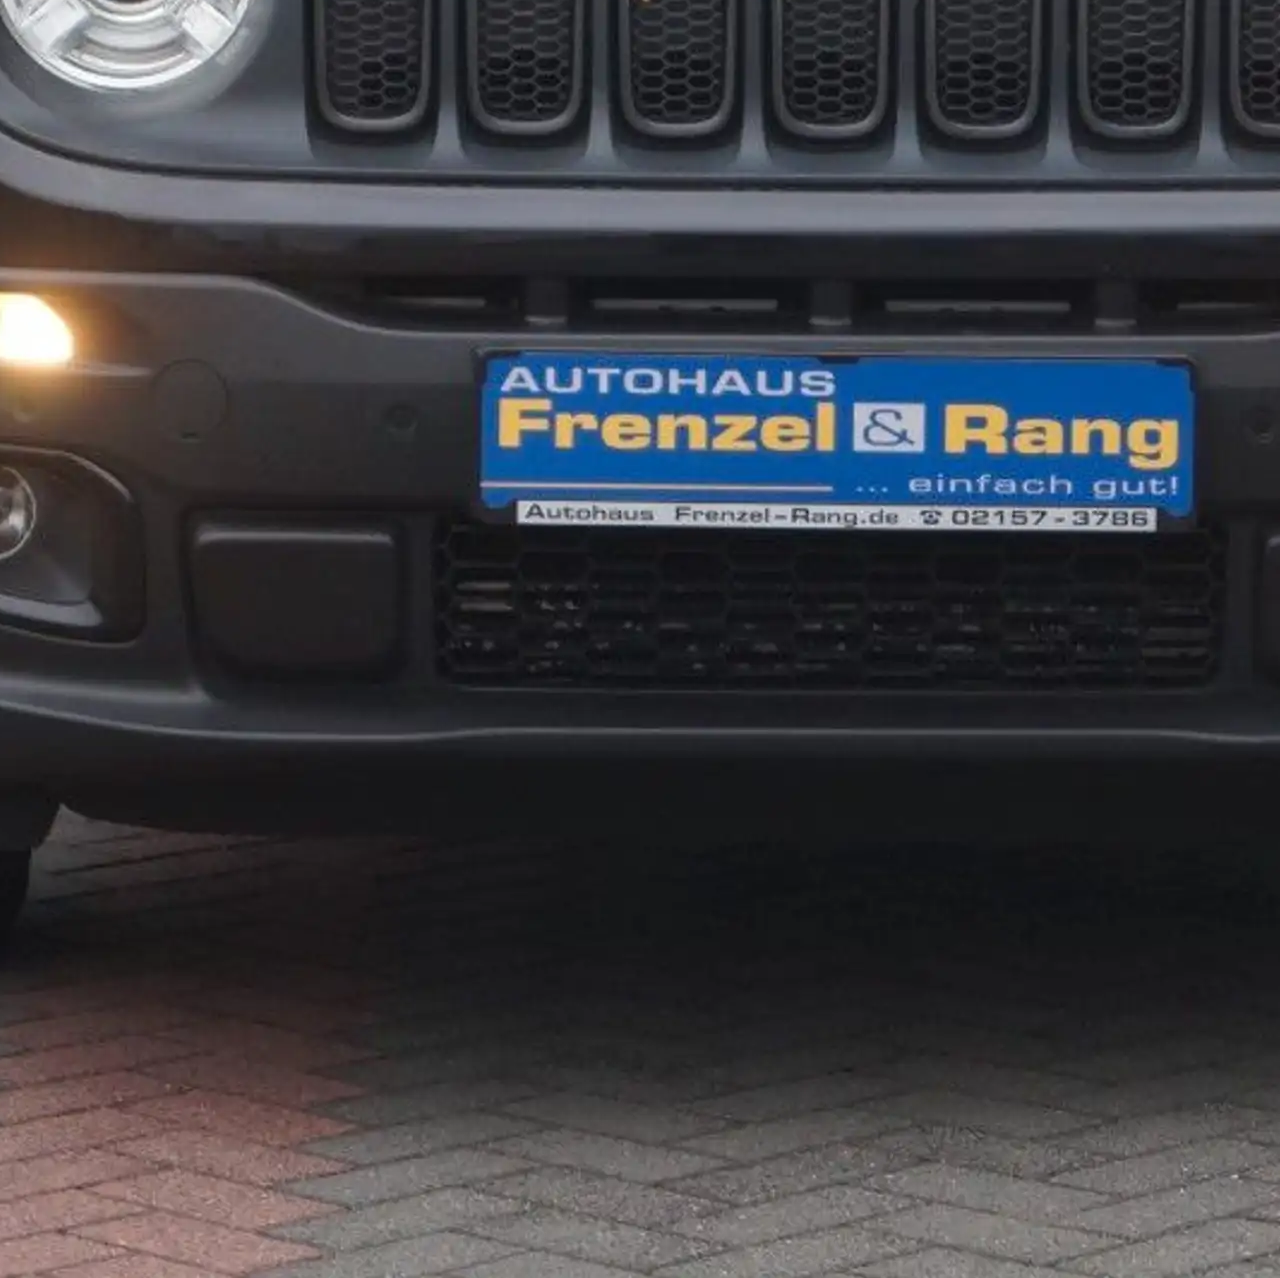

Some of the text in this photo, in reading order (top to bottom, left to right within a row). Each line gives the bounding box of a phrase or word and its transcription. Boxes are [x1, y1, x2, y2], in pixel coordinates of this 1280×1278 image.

[499, 366, 837, 397] AUTOHAUS
[497, 397, 1180, 470] Frenzel & Rang
[907, 473, 1074, 497] einfach
[1092, 476, 1180, 501] gut!
[524, 503, 656, 523] Autohaus
[674, 505, 900, 529] Frenzel-Rang.de
